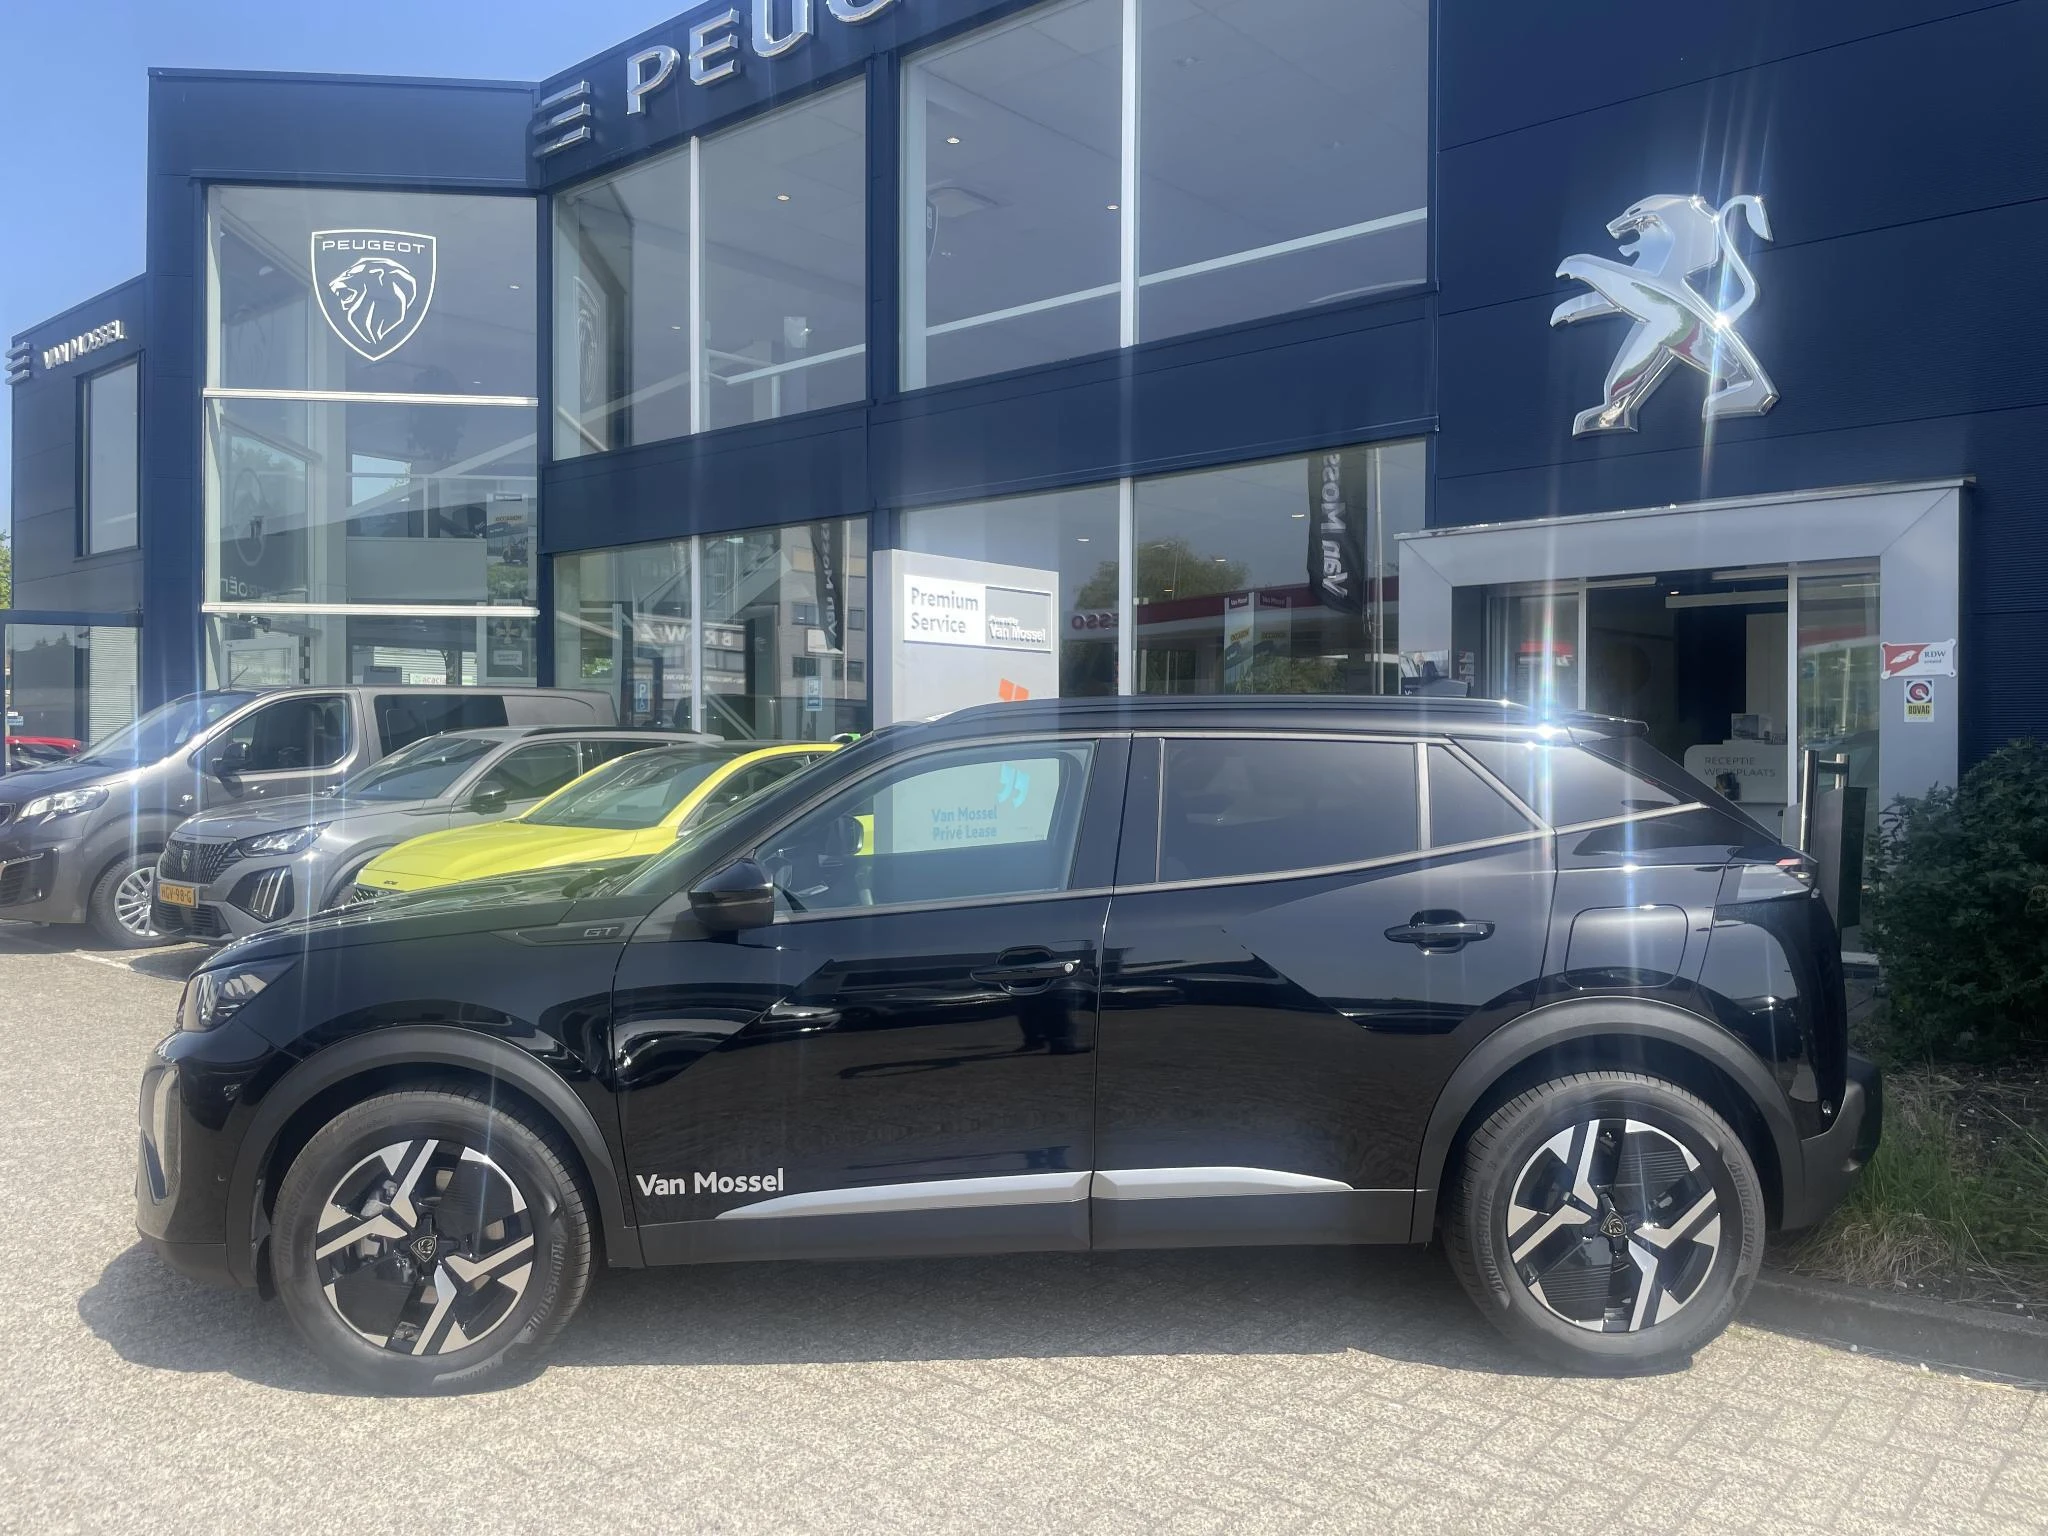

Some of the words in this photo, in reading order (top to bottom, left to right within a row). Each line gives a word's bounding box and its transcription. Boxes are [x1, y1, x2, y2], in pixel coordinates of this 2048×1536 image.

[626, 0, 901, 116] PEU
[322, 239, 425, 254] PEUGEOT
[43, 342, 70, 369] VAN
[70, 320, 126, 360] MOSSEL
[911, 587, 979, 611] Premium
[911, 612, 967, 634] Service
[989, 624, 1008, 640] Van
[1011, 626, 1046, 643] Mossel
[1908, 705, 1930, 715] BOVAG
[1704, 757, 1756, 766] RECEPTIE
[931, 808, 955, 822] Van
[957, 805, 998, 821] Mossel
[932, 825, 963, 841] Privé
[965, 824, 998, 839] Lease
[583, 926, 620, 938] GT
[636, 1173, 686, 1197] Van
[693, 1167, 784, 1194] Mossel
